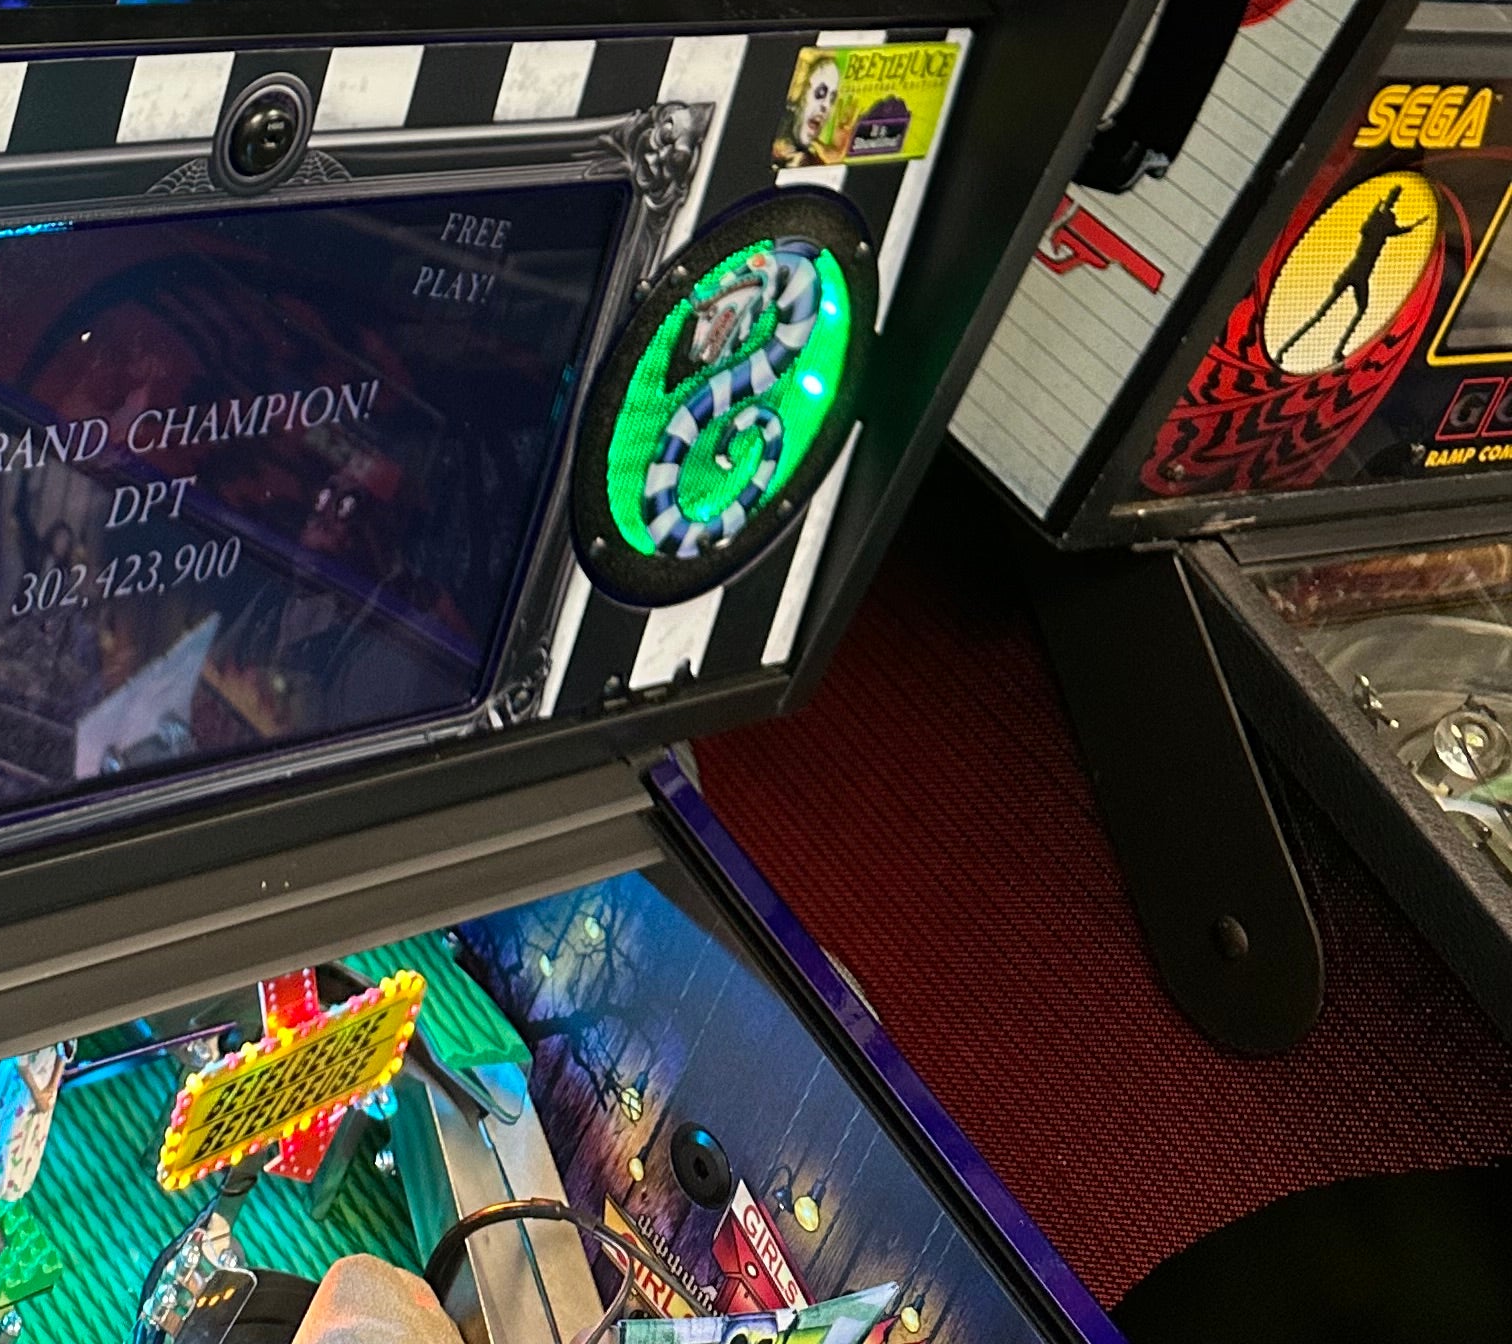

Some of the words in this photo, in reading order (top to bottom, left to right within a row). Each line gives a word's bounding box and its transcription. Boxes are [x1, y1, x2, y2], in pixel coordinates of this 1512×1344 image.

[844, 50, 957, 81] BEETLEJUICE
[1352, 84, 1493, 149] SEGA
[441, 212, 512, 249] FREE
[412, 266, 495, 303] PLAY!
[126, 378, 380, 455] CHAMPION!
[1424, 446, 1476, 468] RAMP
[106, 474, 199, 529] DPT
[11, 537, 241, 615] 302,423,900
[203, 1011, 389, 1123] BETELGEUSE
[192, 1047, 377, 1162] BETELGEUSE
[743, 1203, 798, 1304] GIRLS
